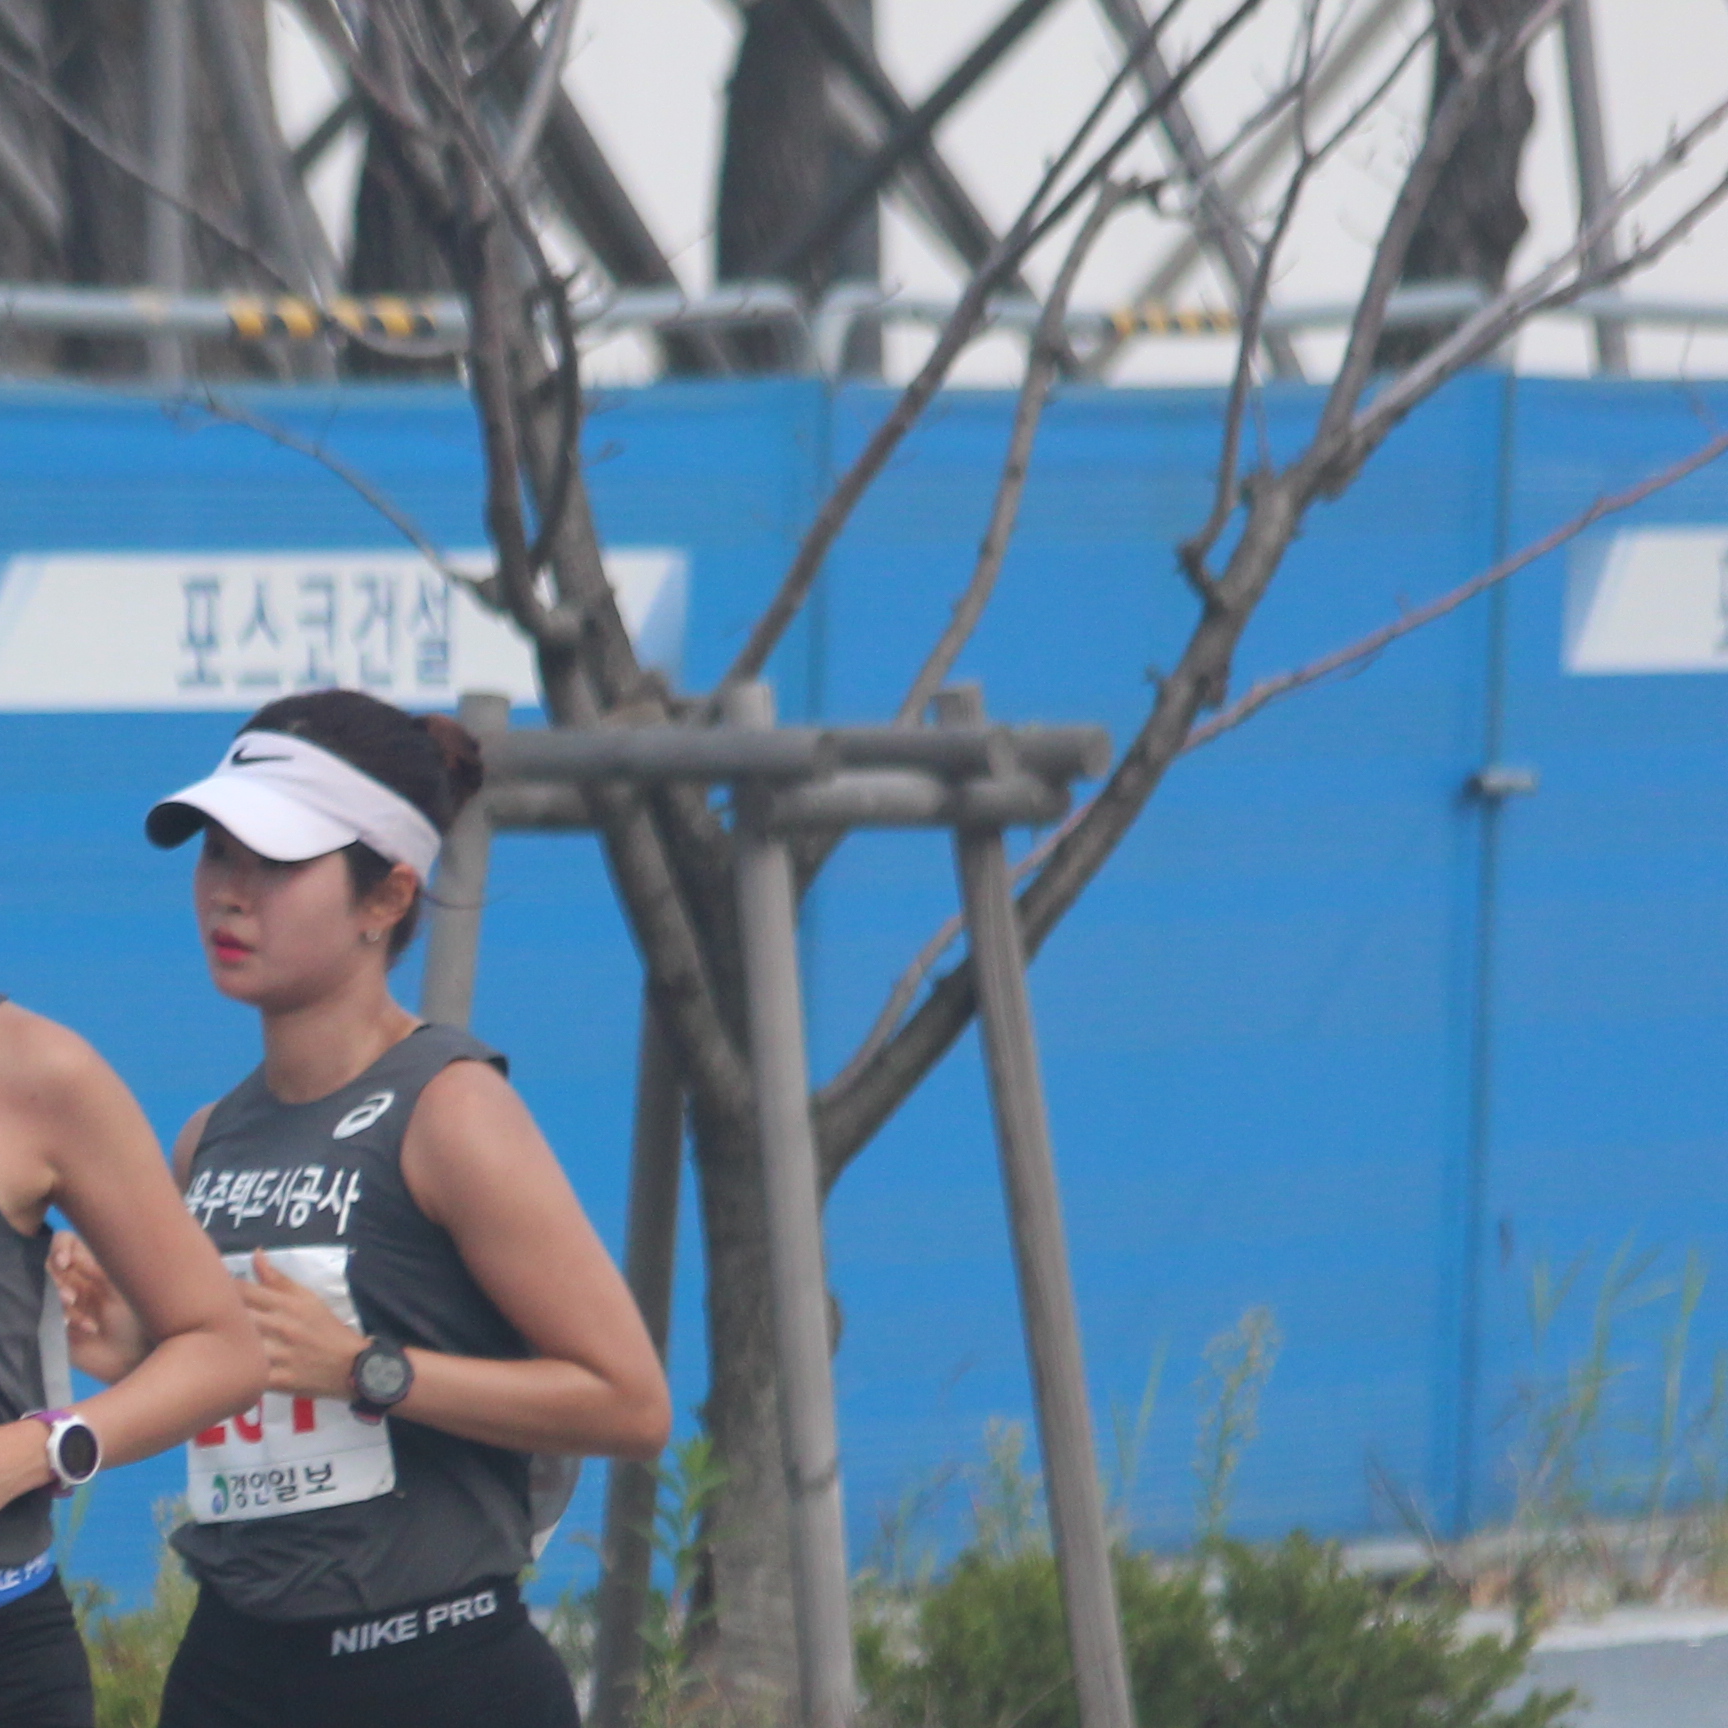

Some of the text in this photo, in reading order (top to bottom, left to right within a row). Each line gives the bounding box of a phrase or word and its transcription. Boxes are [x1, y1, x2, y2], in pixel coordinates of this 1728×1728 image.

[176, 572, 455, 690] 포스코건설
[185, 1164, 362, 1236] 울주택도시공사
[229, 1462, 337, 1509] 경인일보
[330, 1589, 499, 1657] NIKE PRO
